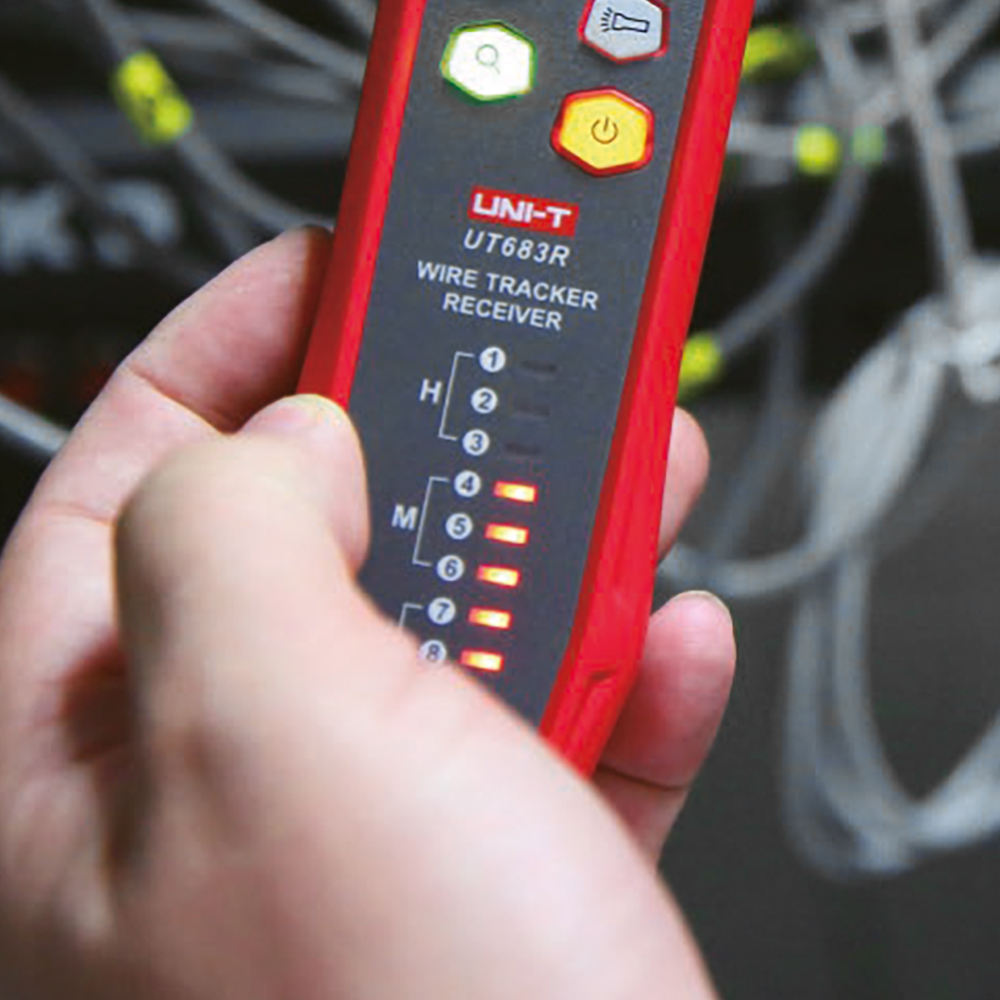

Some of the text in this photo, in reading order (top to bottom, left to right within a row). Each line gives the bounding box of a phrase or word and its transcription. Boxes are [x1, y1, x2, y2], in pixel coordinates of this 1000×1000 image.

[472, 193, 572, 228] UNI-T
[463, 228, 570, 267] UT683R
[417, 260, 598, 310] WIRE TRACKER
[443, 292, 562, 331] RECEIVER
[483, 348, 503, 371] 1
[419, 378, 442, 404] H
[474, 389, 495, 412] 2
[466, 431, 487, 454] 3
[457, 472, 478, 495] 4
[391, 504, 418, 530] M
[448, 515, 470, 537] 5
[440, 557, 461, 580] 6
[432, 600, 453, 623] 7
